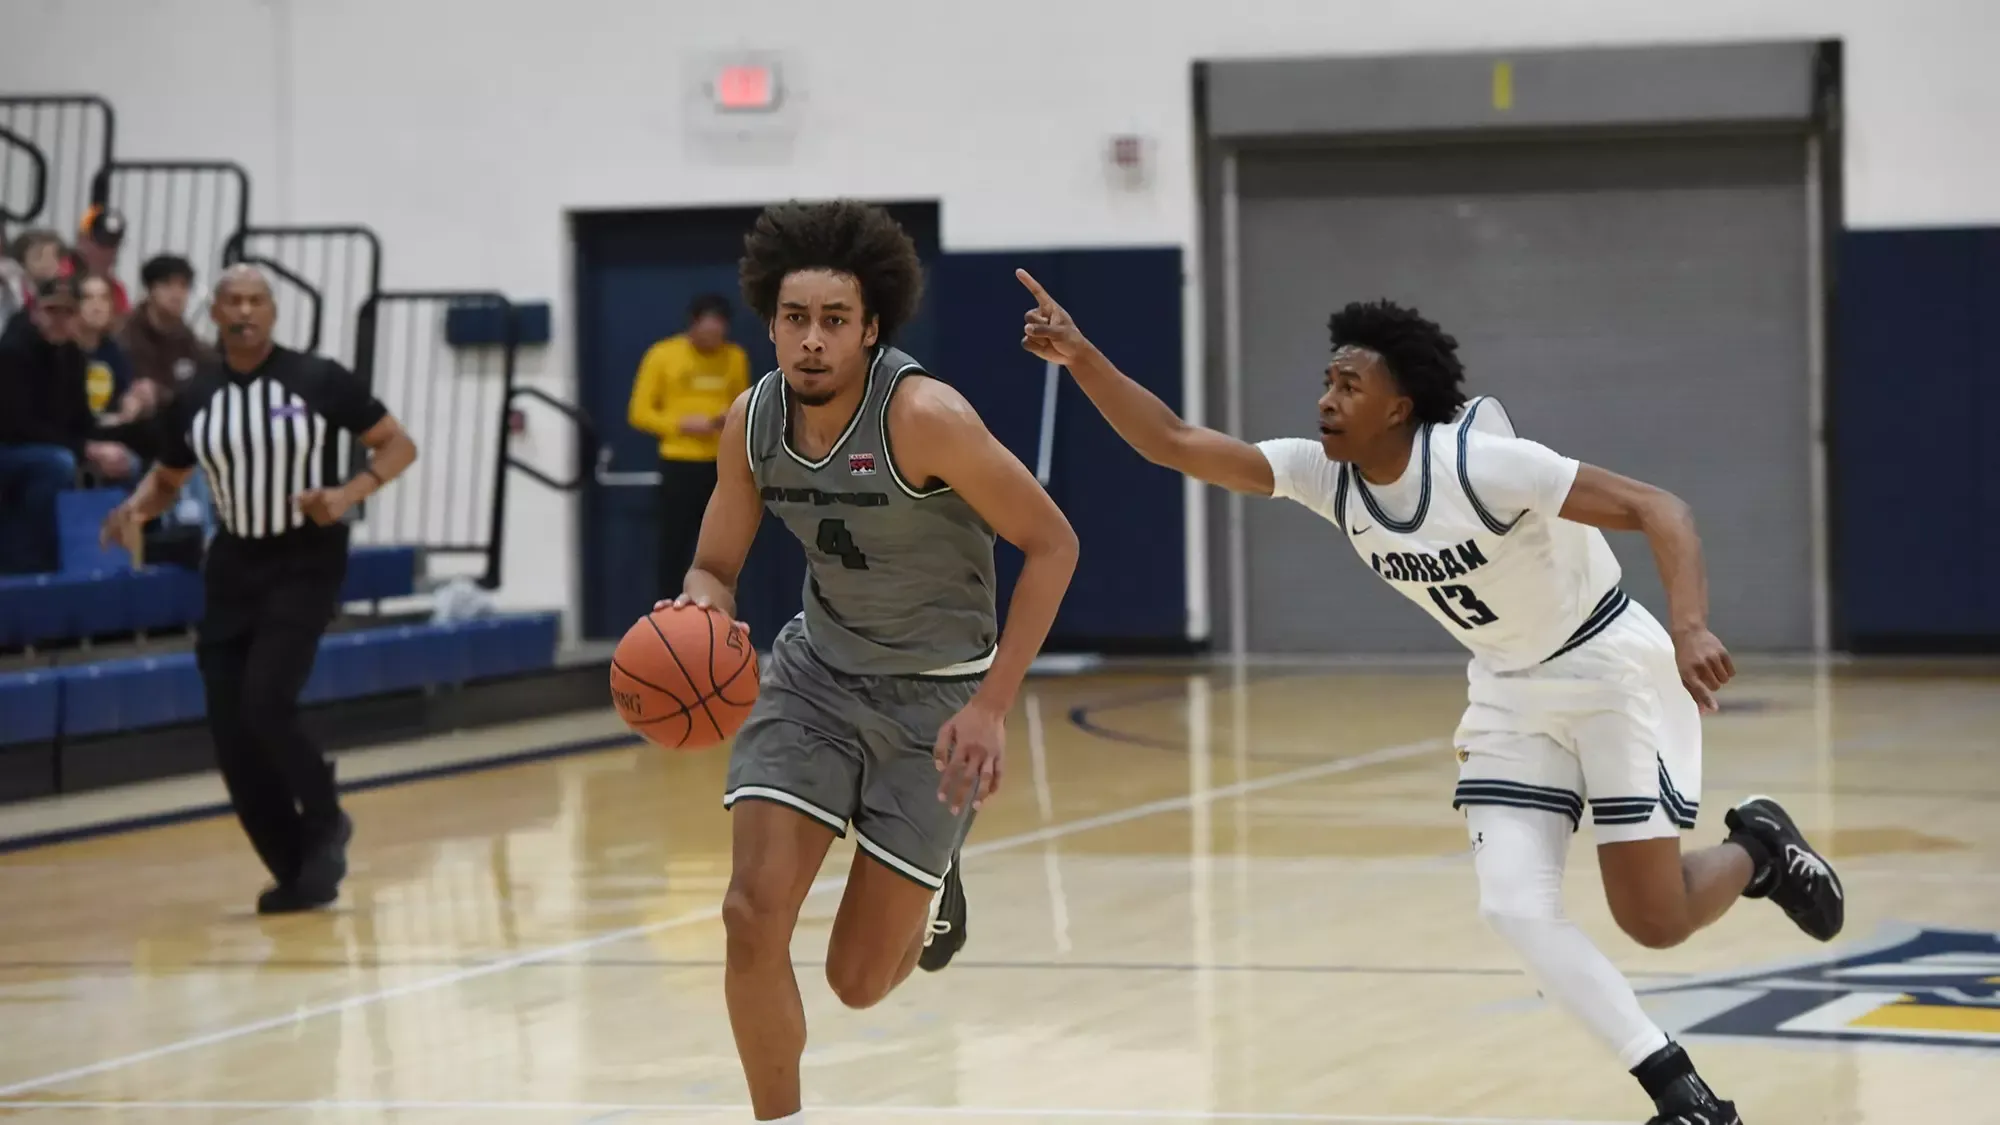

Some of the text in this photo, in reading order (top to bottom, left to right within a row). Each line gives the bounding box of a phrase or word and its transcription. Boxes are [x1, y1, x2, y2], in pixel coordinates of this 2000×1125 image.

[816, 518, 869, 570] 4
[1371, 538, 1488, 582] CORBAN
[1427, 584, 1499, 630] 13
